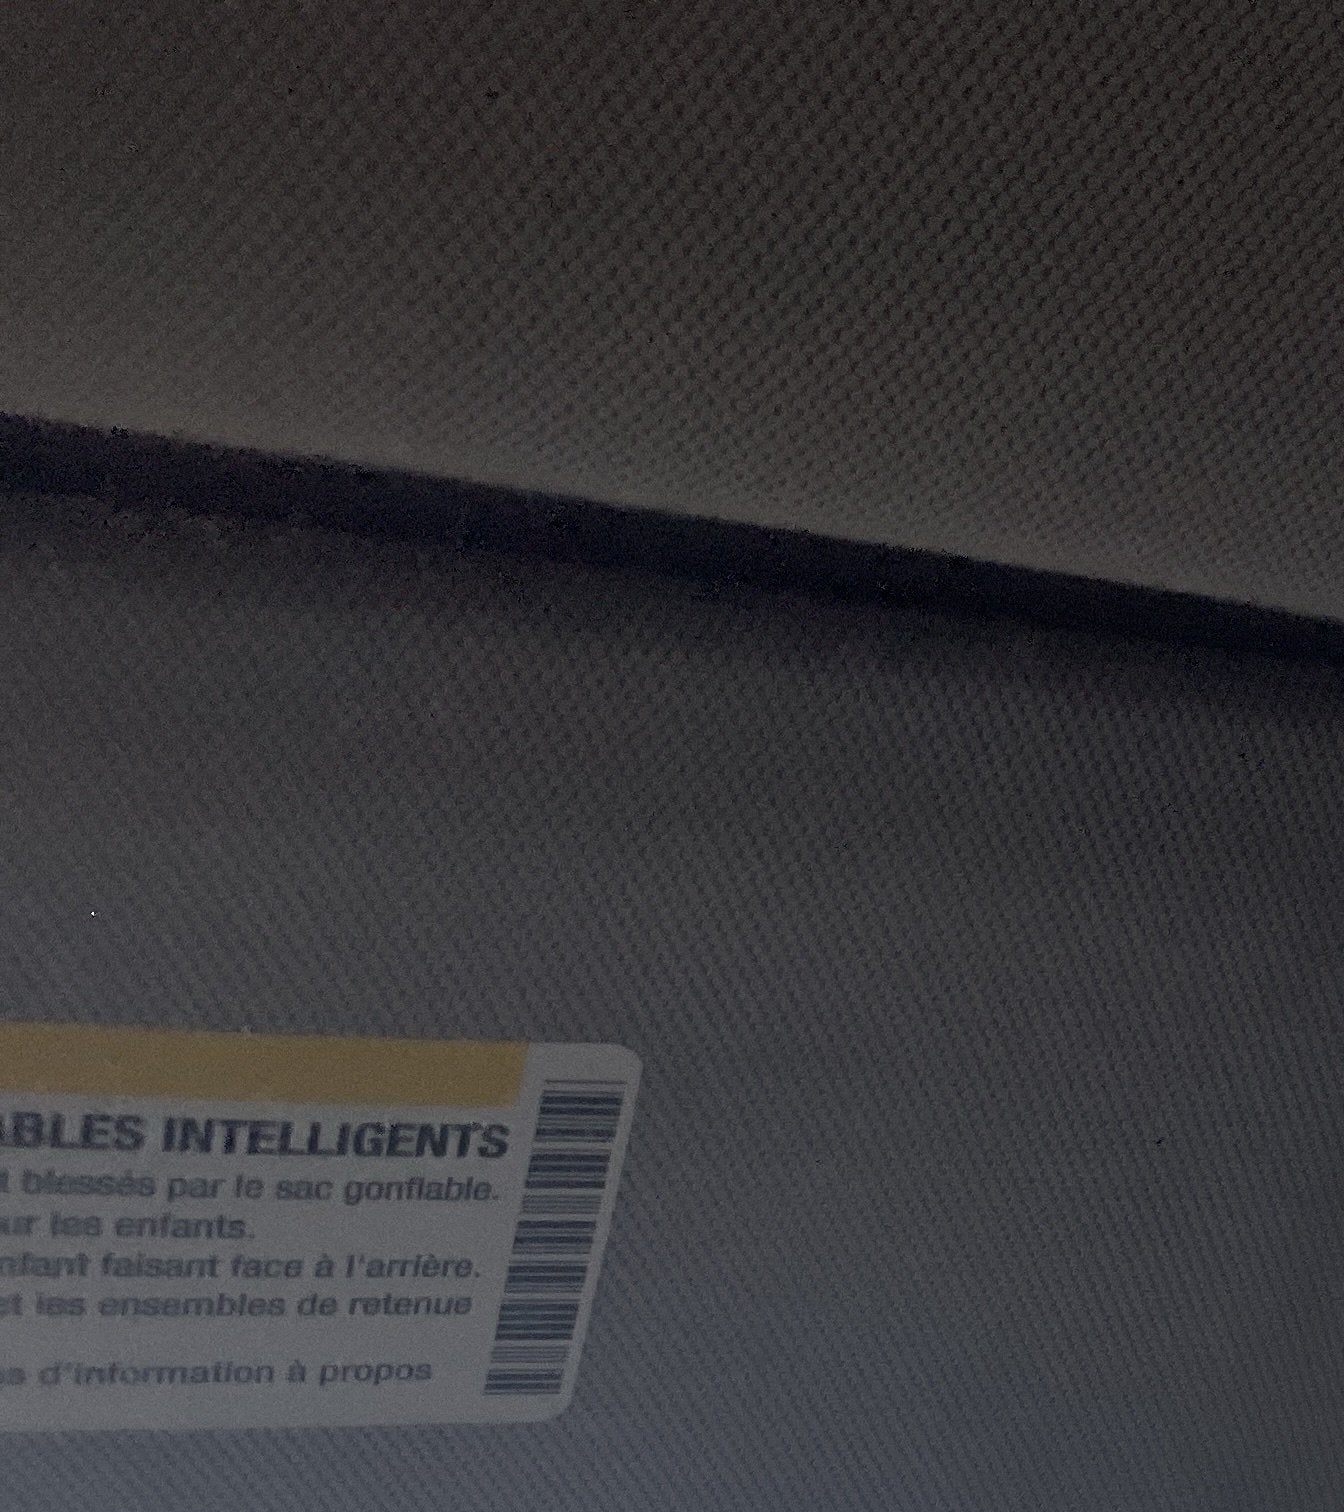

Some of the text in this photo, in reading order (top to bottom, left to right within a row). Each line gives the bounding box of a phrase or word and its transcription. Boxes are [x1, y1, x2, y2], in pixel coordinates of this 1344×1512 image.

[0, 1110, 510, 1159] BLES INTELLIGENTS
[167, 1177, 227, 1202] par
[235, 1174, 265, 1199] le
[275, 1179, 333, 1201] sac
[343, 1176, 499, 1206] gonflable.
[51, 1211, 102, 1239] les
[115, 1212, 255, 1240] enfants.
[102, 1251, 220, 1278] faisant
[232, 1254, 304, 1279] face
[314, 1253, 335, 1279] à
[36, 1292, 86, 1316] les
[98, 1293, 287, 1316] ensembles
[297, 1293, 338, 1317] de
[349, 1294, 473, 1316] retenue
[287, 1359, 307, 1385] à
[320, 1363, 433, 1387] propos
